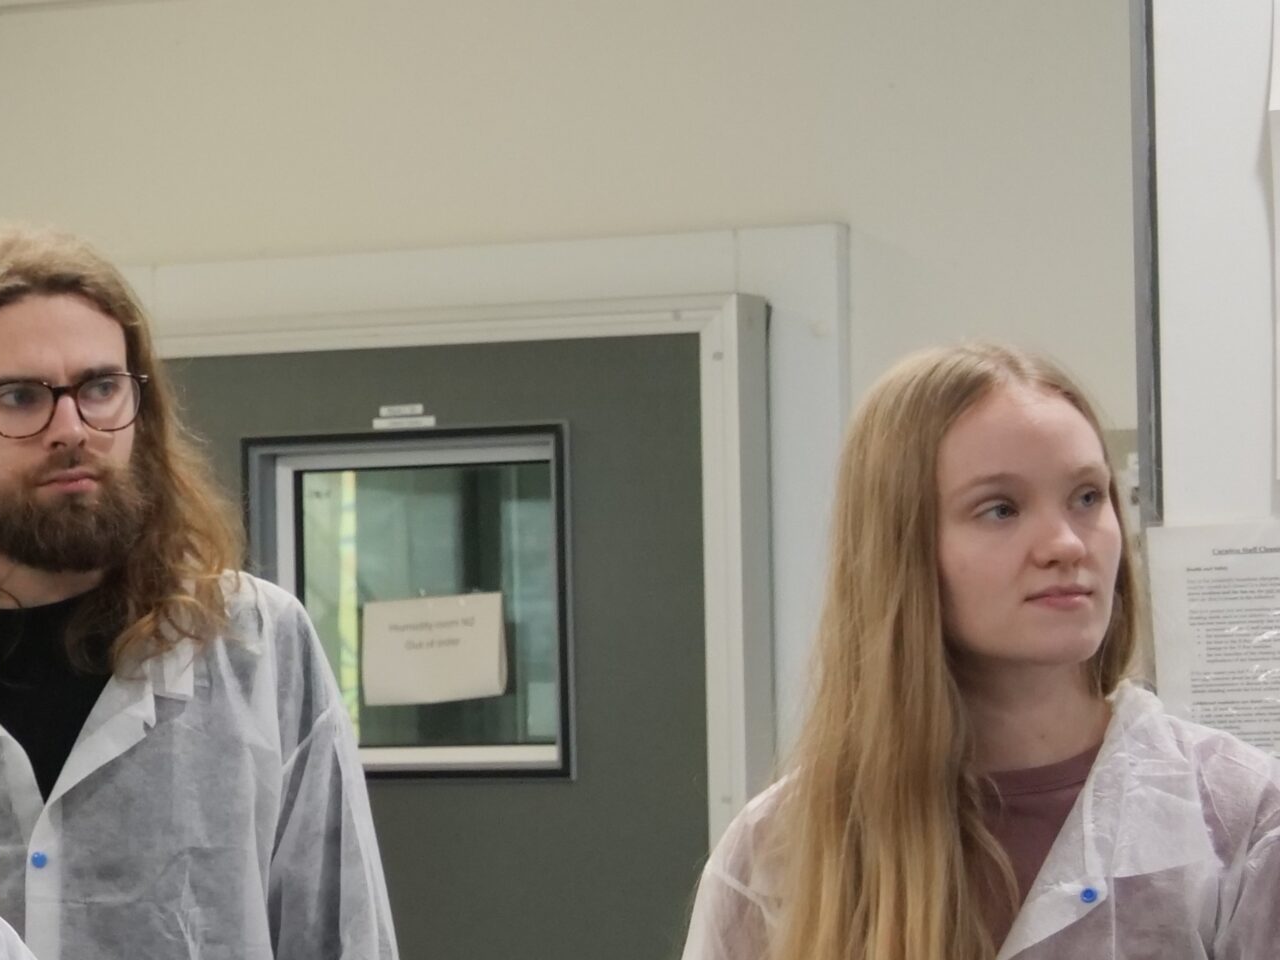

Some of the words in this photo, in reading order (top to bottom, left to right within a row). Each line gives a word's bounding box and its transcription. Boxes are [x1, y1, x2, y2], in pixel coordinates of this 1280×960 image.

[404, 639, 423, 650] Out
[426, 638, 434, 648] of
[436, 637, 461, 648] order
